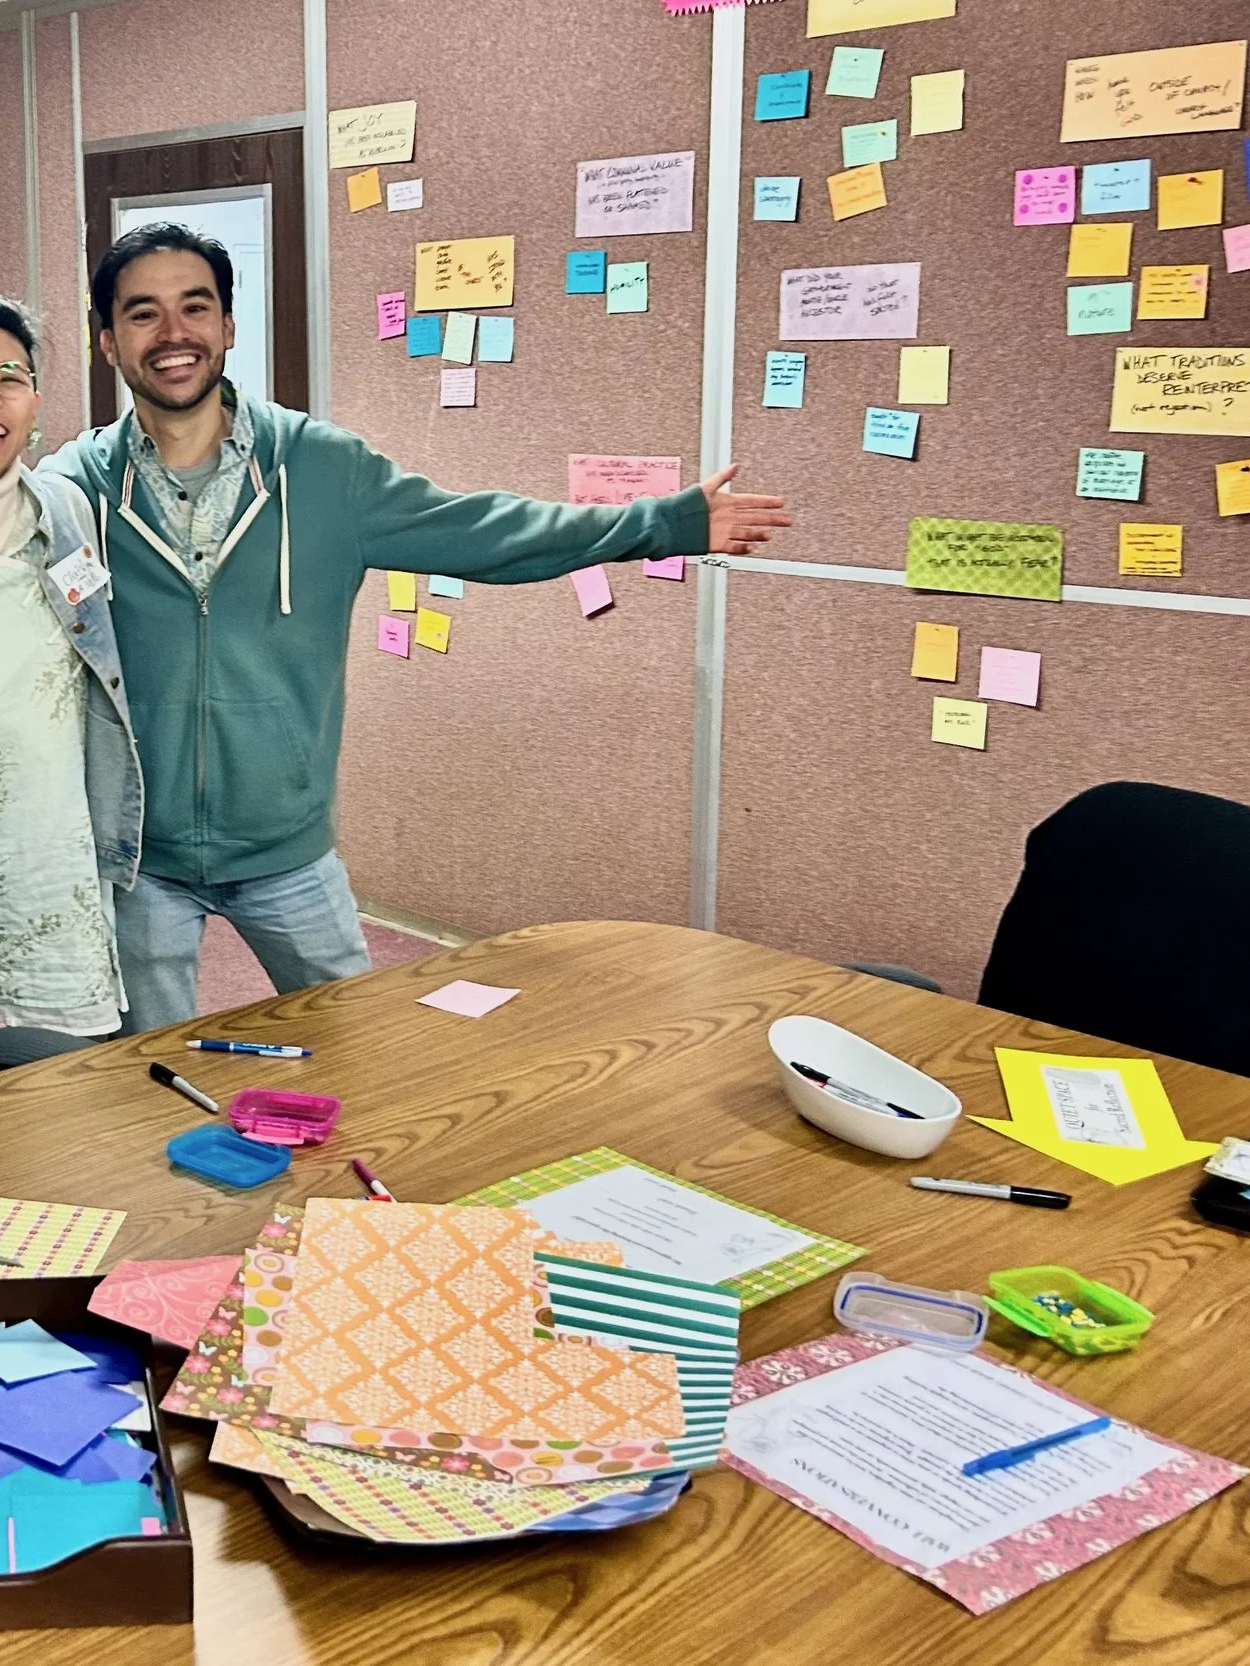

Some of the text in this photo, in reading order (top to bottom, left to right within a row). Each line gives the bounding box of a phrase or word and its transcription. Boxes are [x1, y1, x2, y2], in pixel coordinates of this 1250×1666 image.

[1123, 354, 1245, 370] WHAT TRADITIONS
[1137, 370, 1193, 384] DESERVE
[1053, 1080, 1073, 1102] SPACE
